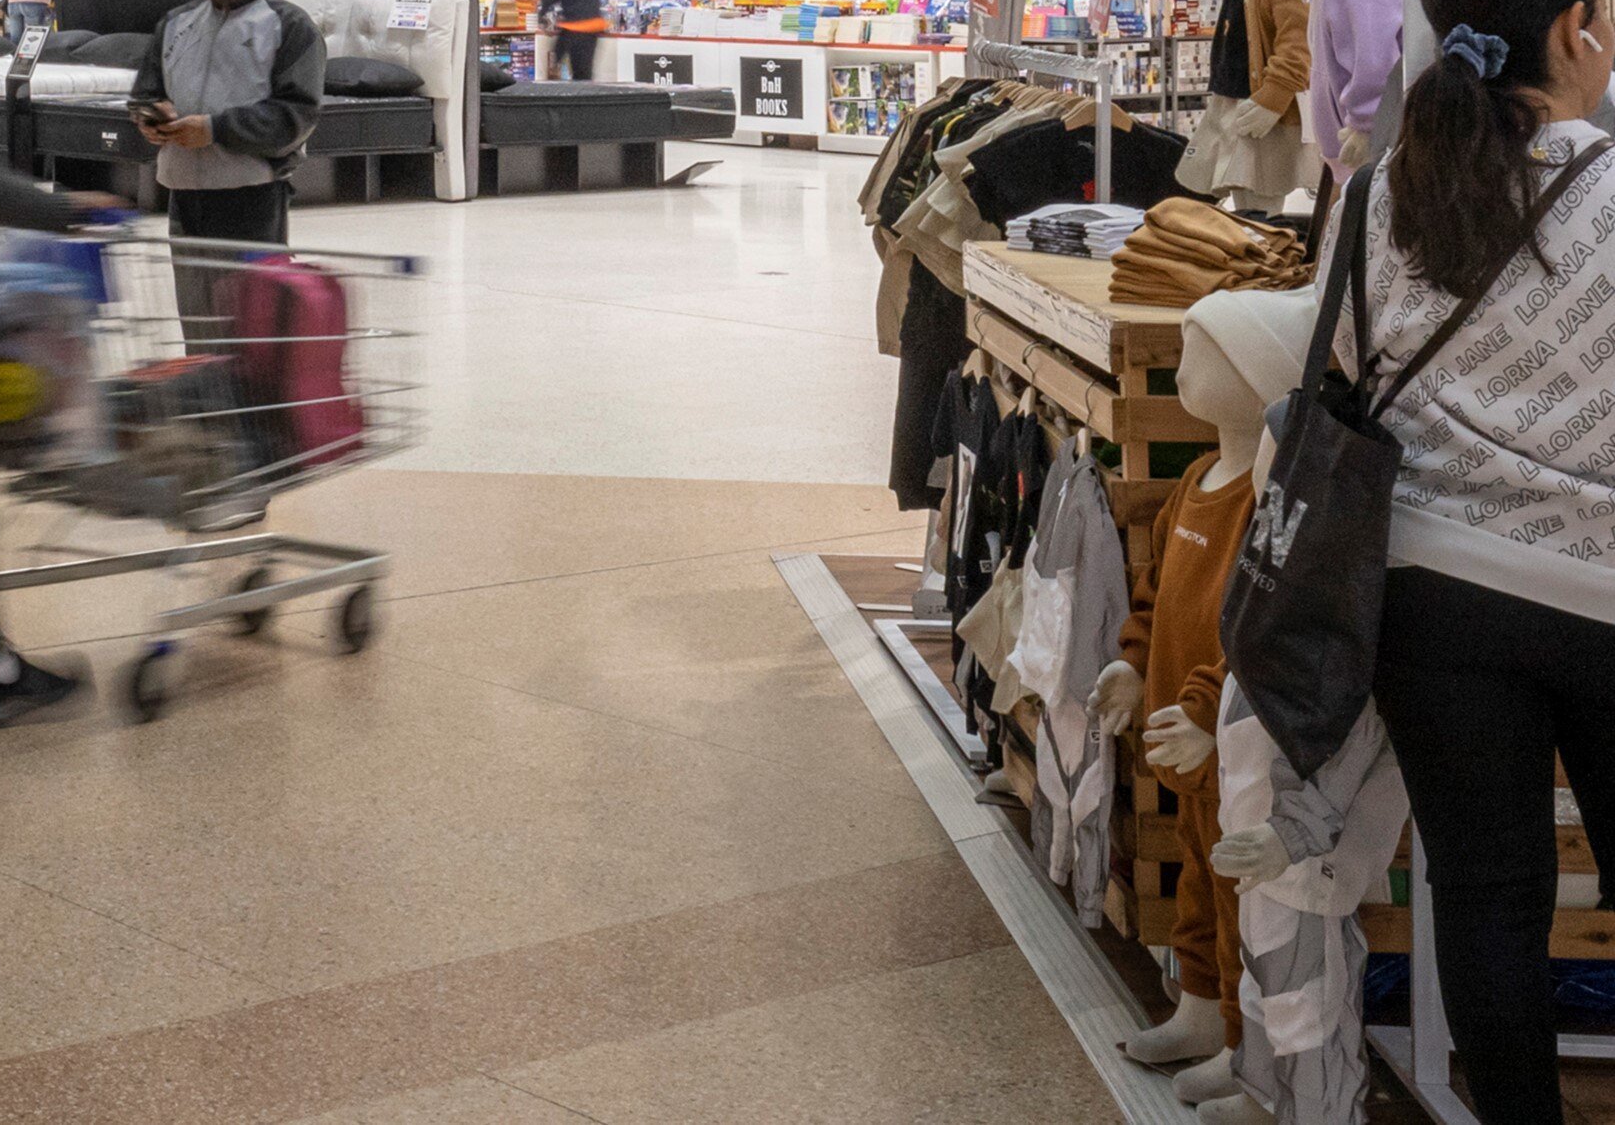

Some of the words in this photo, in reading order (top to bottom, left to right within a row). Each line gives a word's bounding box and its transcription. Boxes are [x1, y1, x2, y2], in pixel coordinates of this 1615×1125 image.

[755, 98, 788, 116] BOOKS
[760, 76, 782, 94] BnH
[1456, 322, 1513, 376] JANE
[1514, 240, 1596, 326] LORNA
[1475, 339, 1558, 409] LORNA
[1556, 275, 1615, 344] JANE
[1515, 371, 1578, 434] JANE
